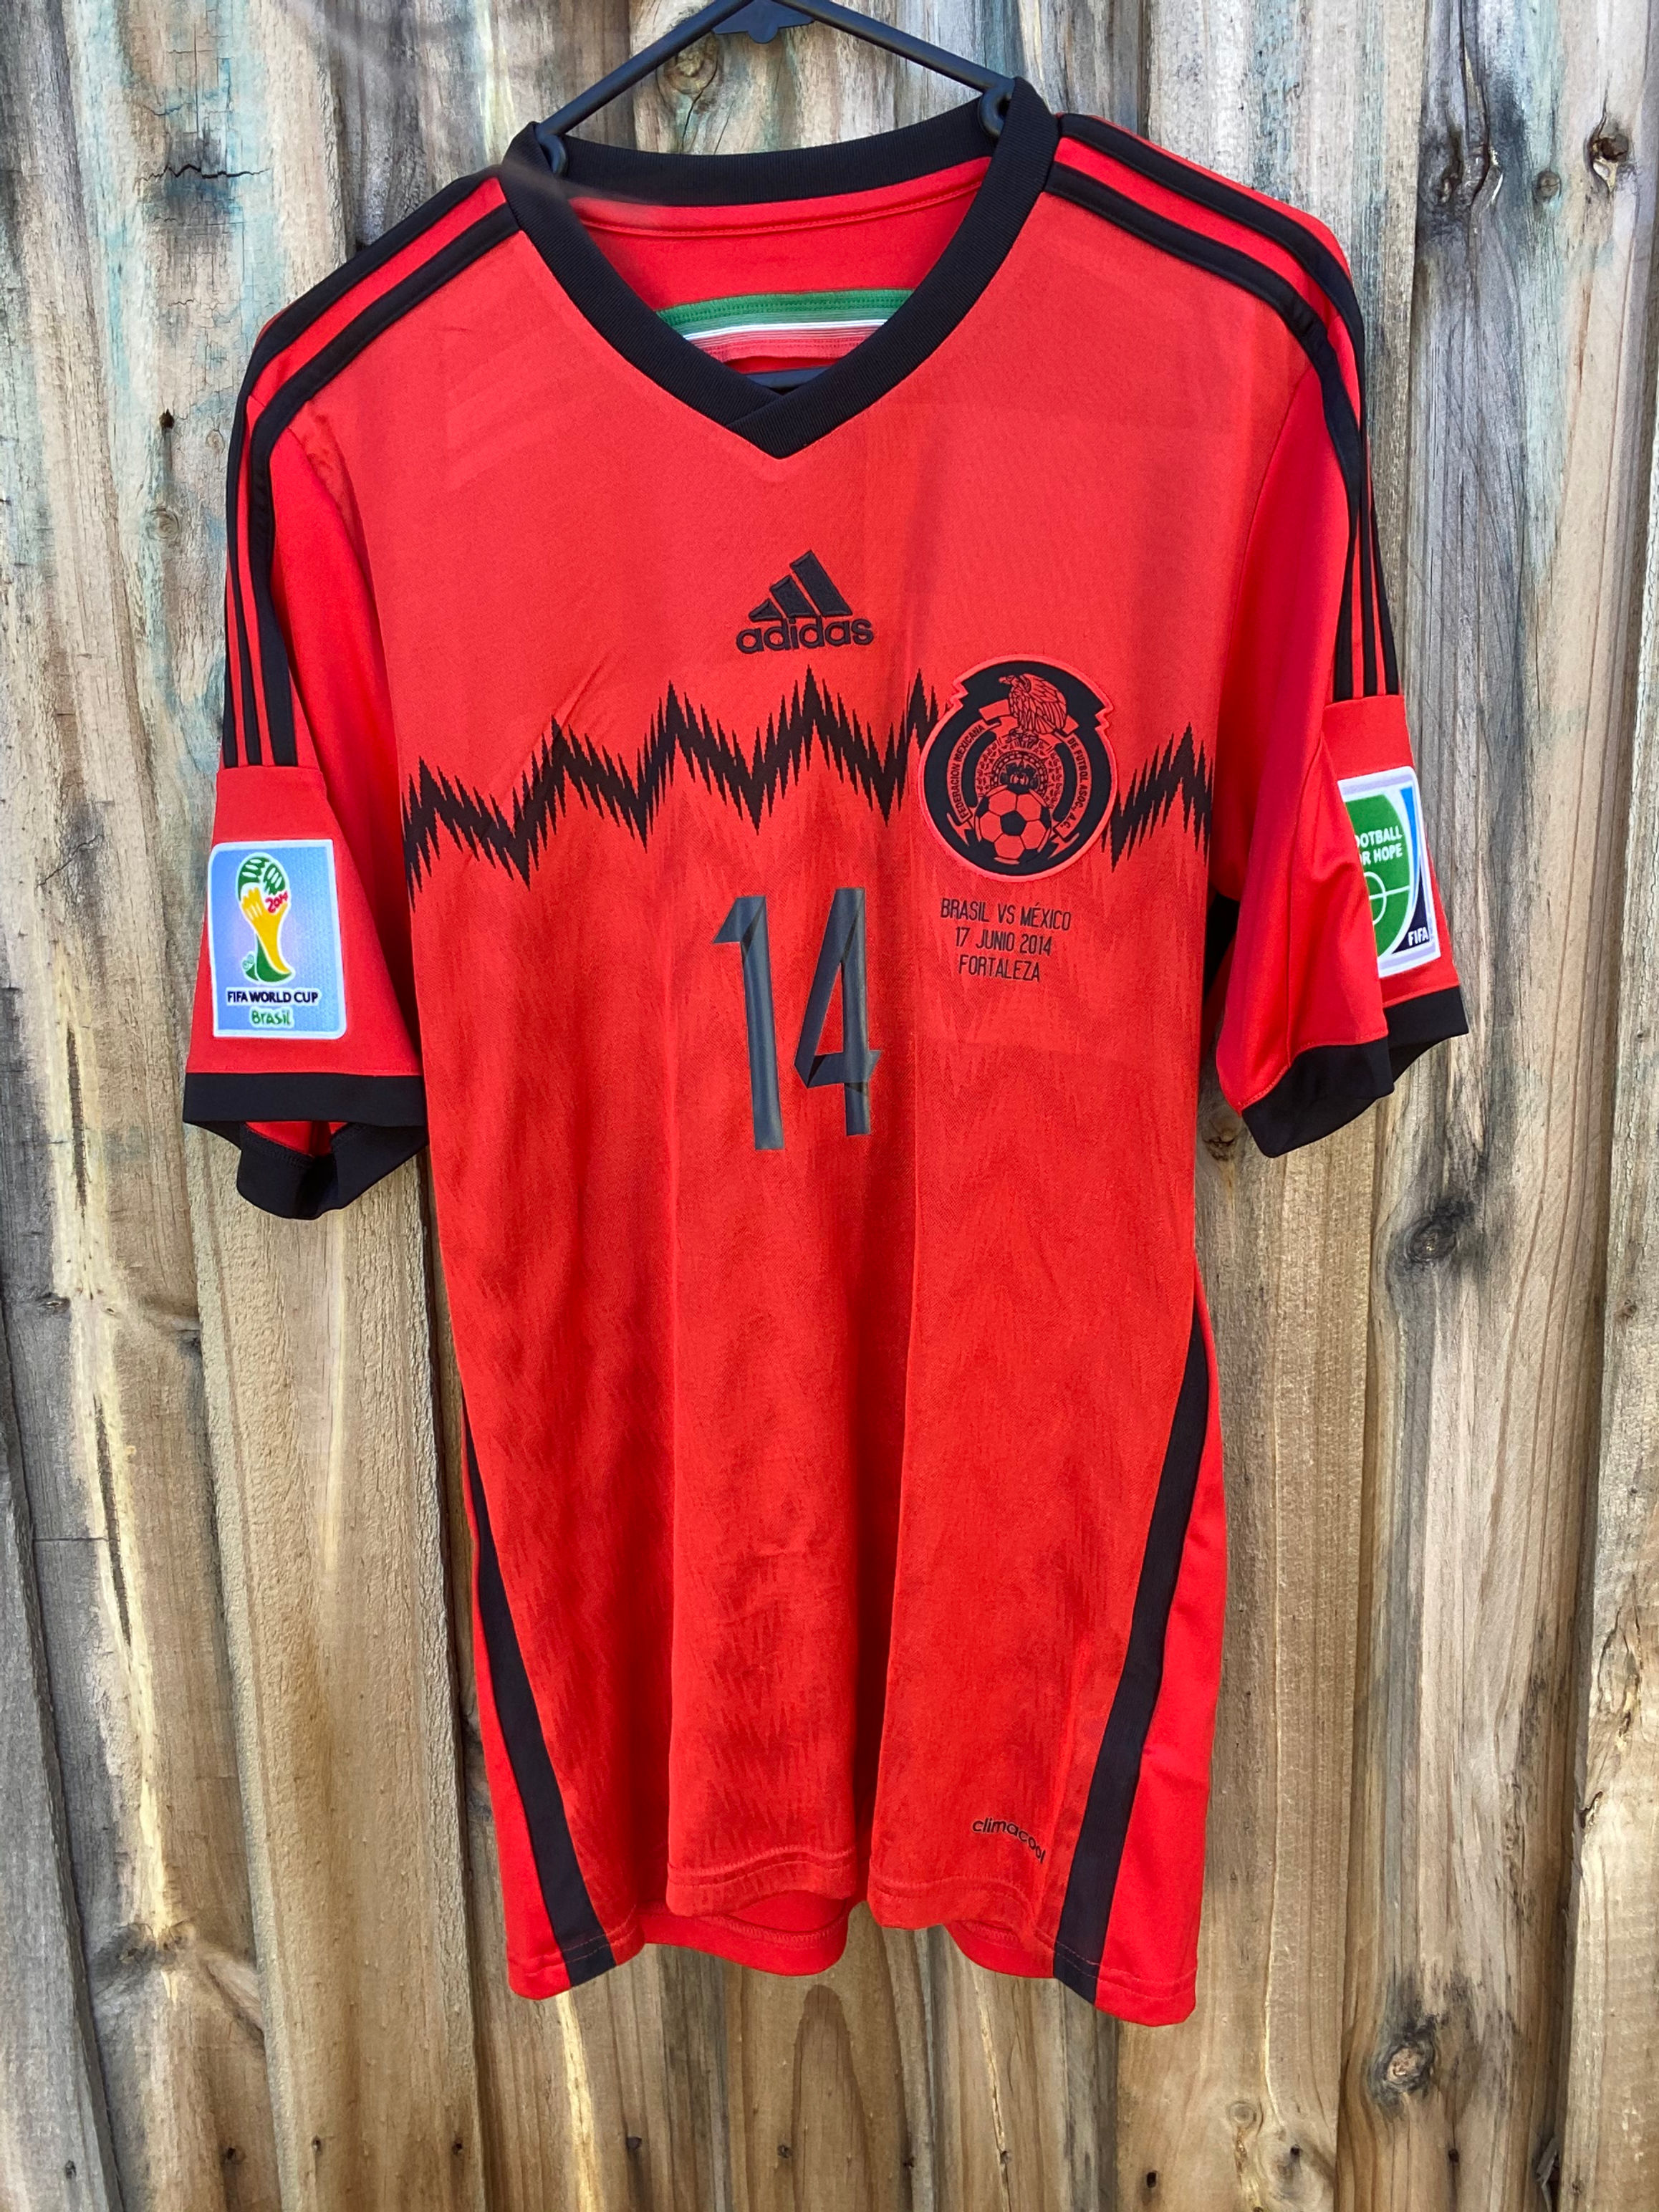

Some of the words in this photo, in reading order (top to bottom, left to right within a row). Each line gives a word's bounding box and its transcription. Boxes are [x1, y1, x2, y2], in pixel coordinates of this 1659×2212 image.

[736, 615, 875, 655] adidas
[953, 724, 986, 762] MEXICANA
[1067, 737, 1079, 750] DE
[1074, 749, 1089, 783] FUTBOL
[950, 763, 969, 819] FEDERACION
[1355, 825, 1403, 848] OTBALL
[1373, 842, 1403, 863] HOPE
[941, 898, 990, 923] BRASIL
[998, 903, 1016, 925] VS
[1020, 902, 1072, 931] MÉXICO
[956, 926, 971, 947] 17
[976, 929, 1015, 952] JUNIO
[1019, 933, 1052, 956] 2014
[1408, 927, 1429, 946] FIFA
[958, 954, 1040, 982] FORTALEZA
[227, 991, 248, 1003] FIFA
[249, 991, 292, 1003] WORLD
[294, 991, 318, 1003] CUP
[252, 1009, 290, 1024] Brasil
[713, 888, 883, 1150] 14
[972, 1817, 1046, 1864] climacool
